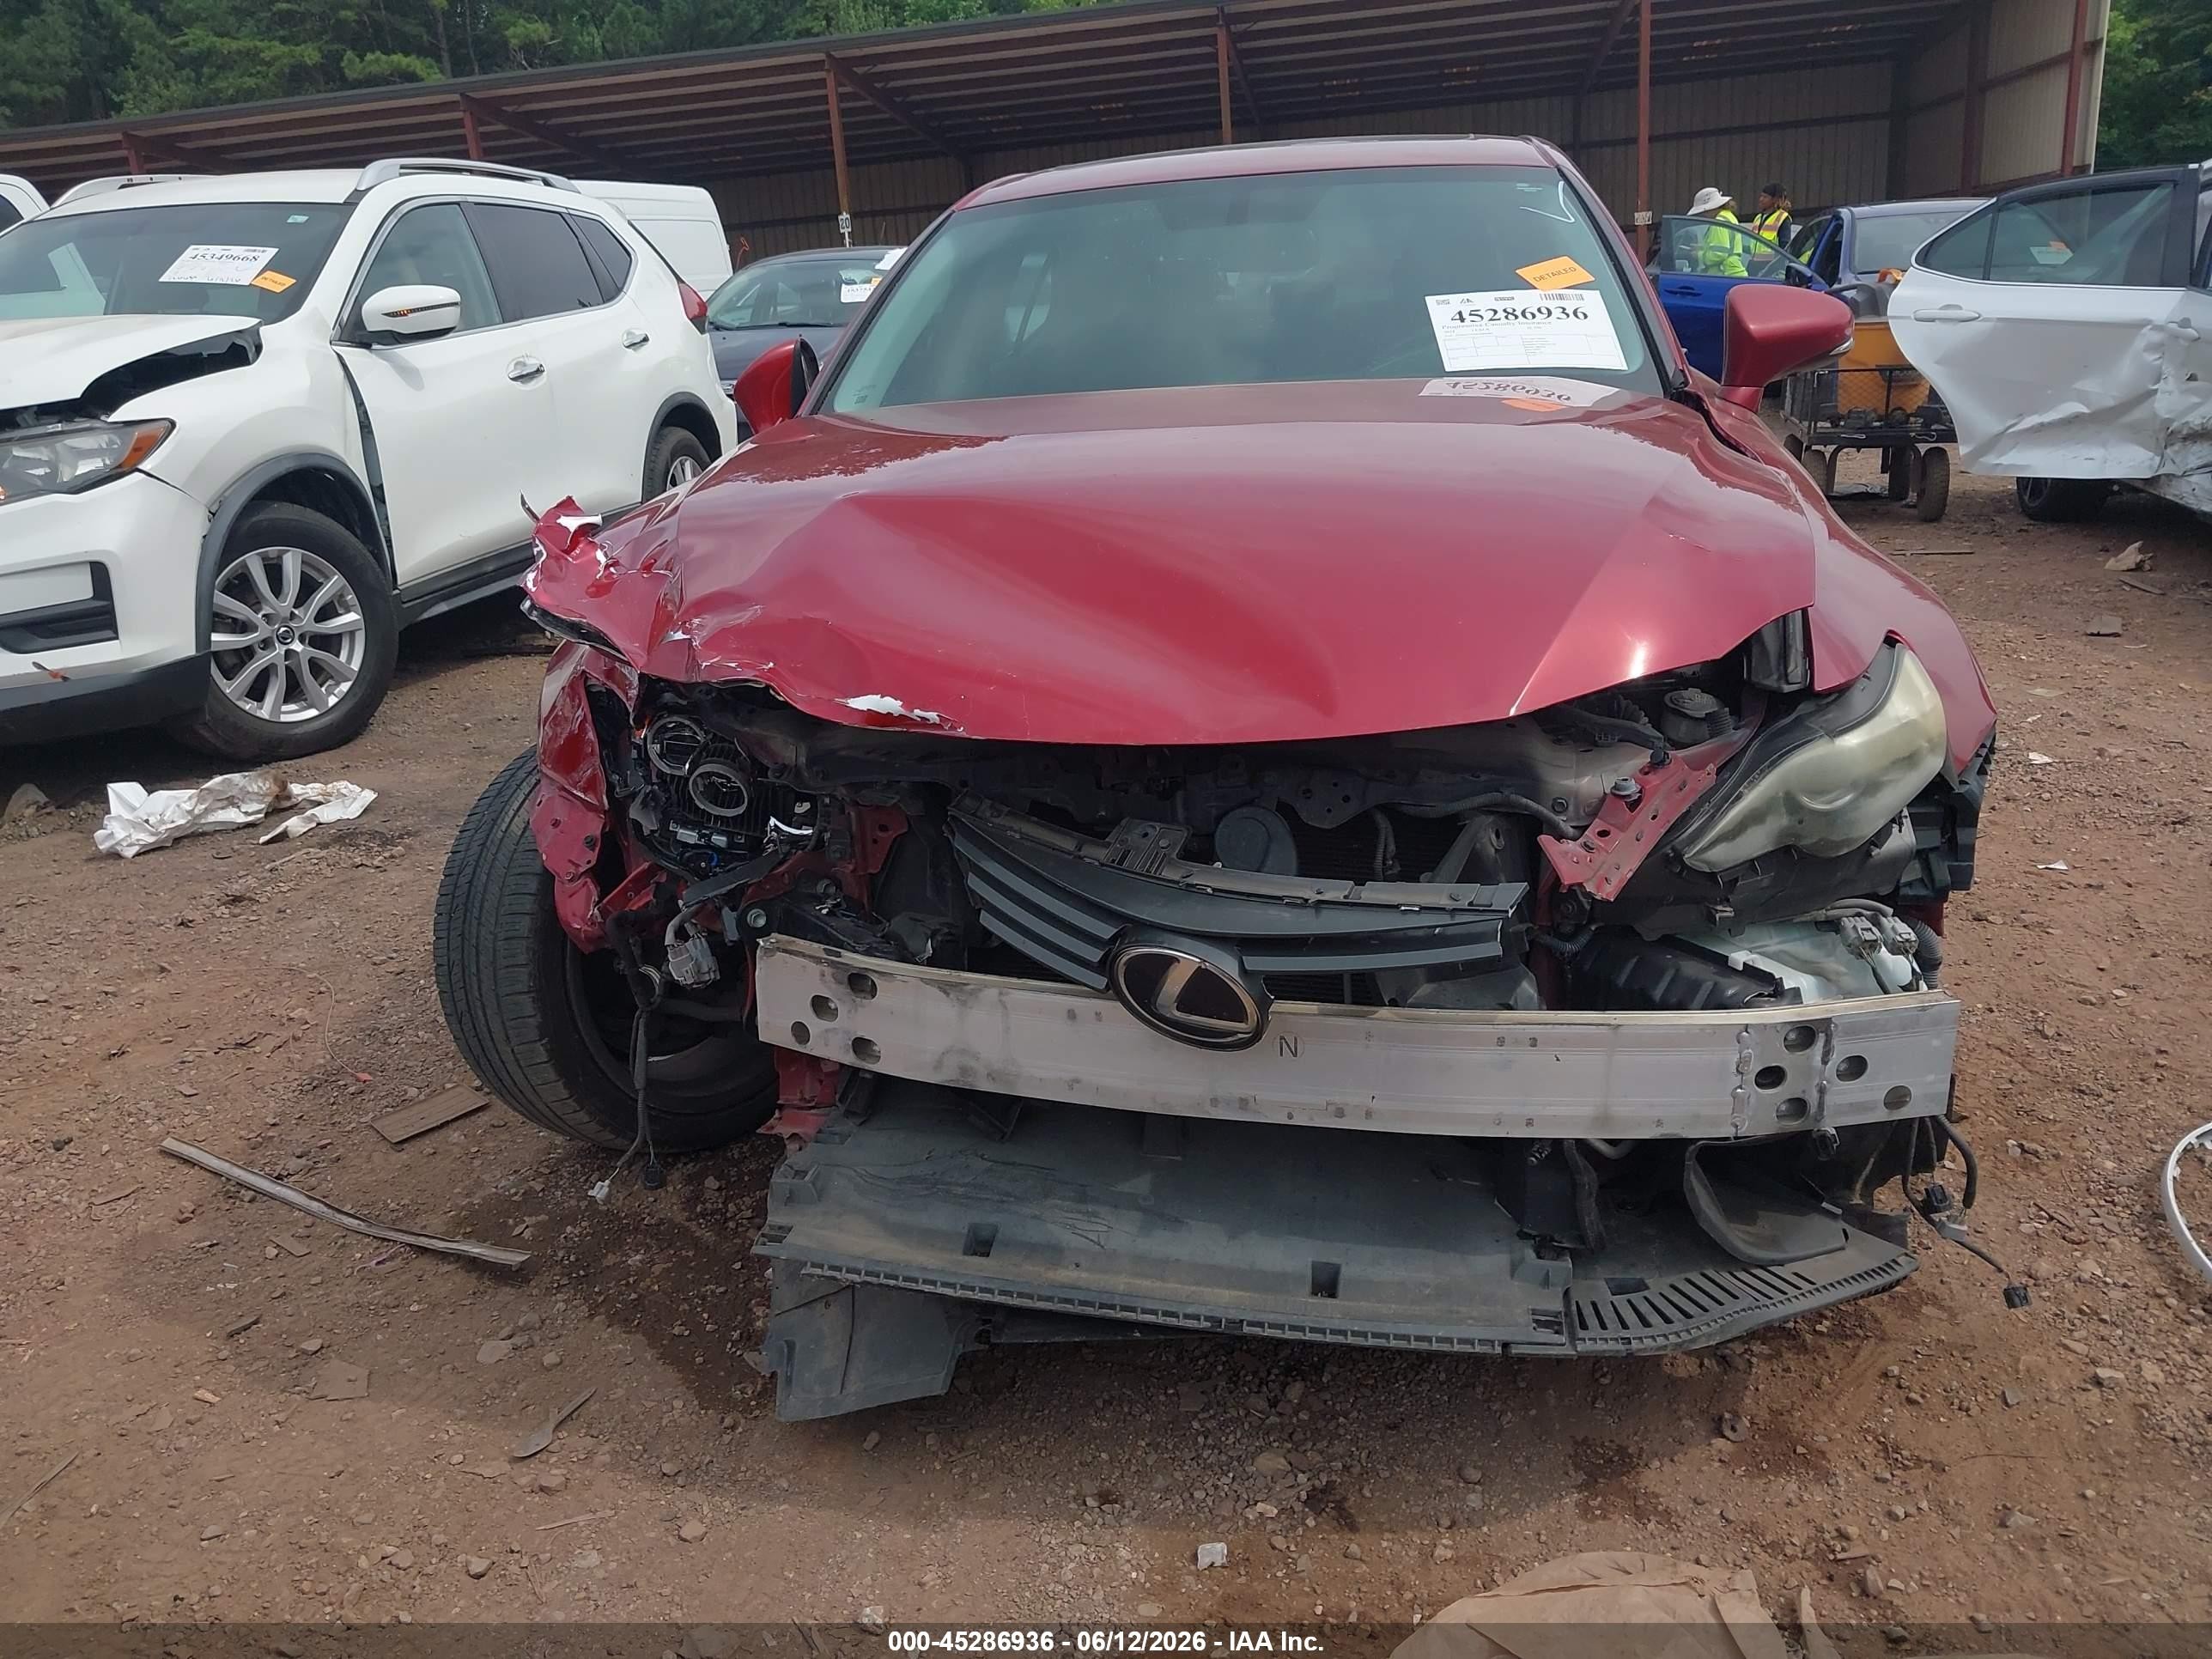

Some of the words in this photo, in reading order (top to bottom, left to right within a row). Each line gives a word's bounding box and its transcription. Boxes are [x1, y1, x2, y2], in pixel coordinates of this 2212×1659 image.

[840, 216, 850, 230] 20
[190, 252, 260, 262] 45349668
[1533, 266, 1577, 283] DETAILED
[1450, 306, 1589, 324] 45286936
[1279, 1036, 1297, 1057] N
